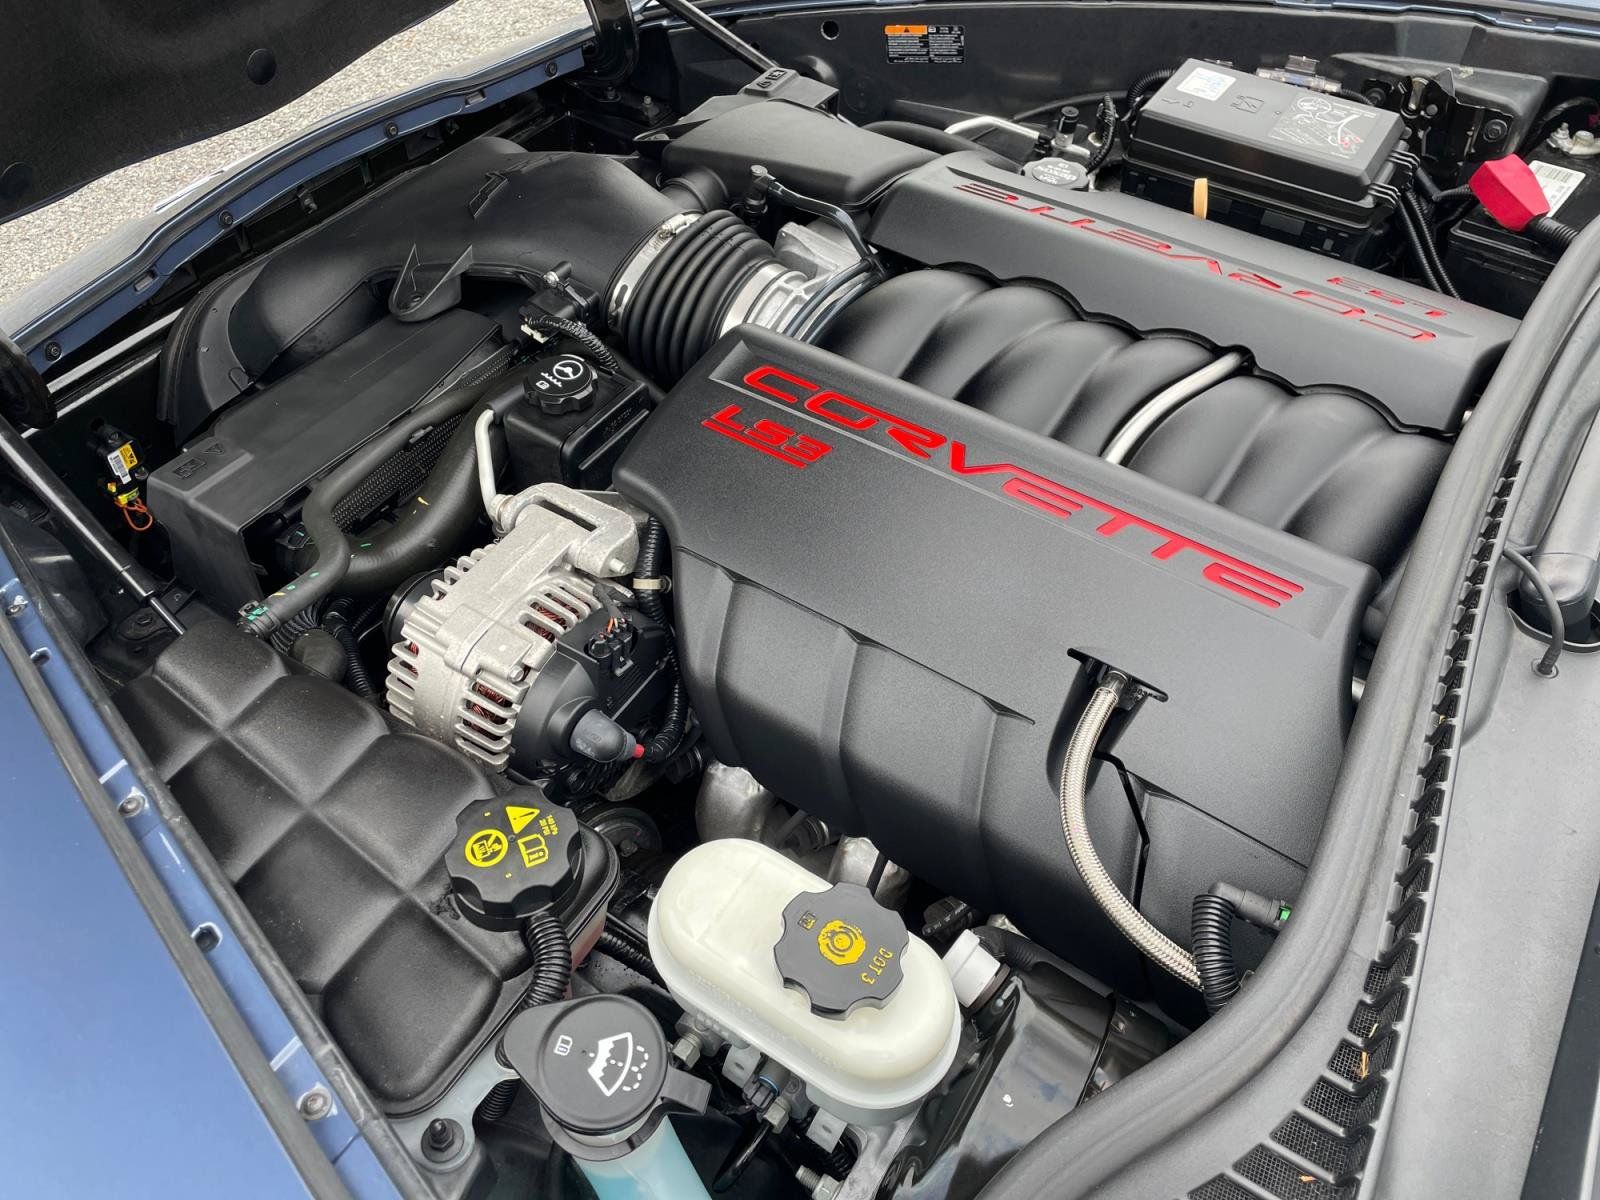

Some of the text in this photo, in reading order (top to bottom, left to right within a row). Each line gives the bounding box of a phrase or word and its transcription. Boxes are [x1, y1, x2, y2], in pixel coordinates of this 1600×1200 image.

[953, 182, 1437, 343] CORVETTE
[701, 403, 834, 470] LS3
[743, 364, 1305, 609] CORVETTE
[861, 947, 893, 985] DOT 3
